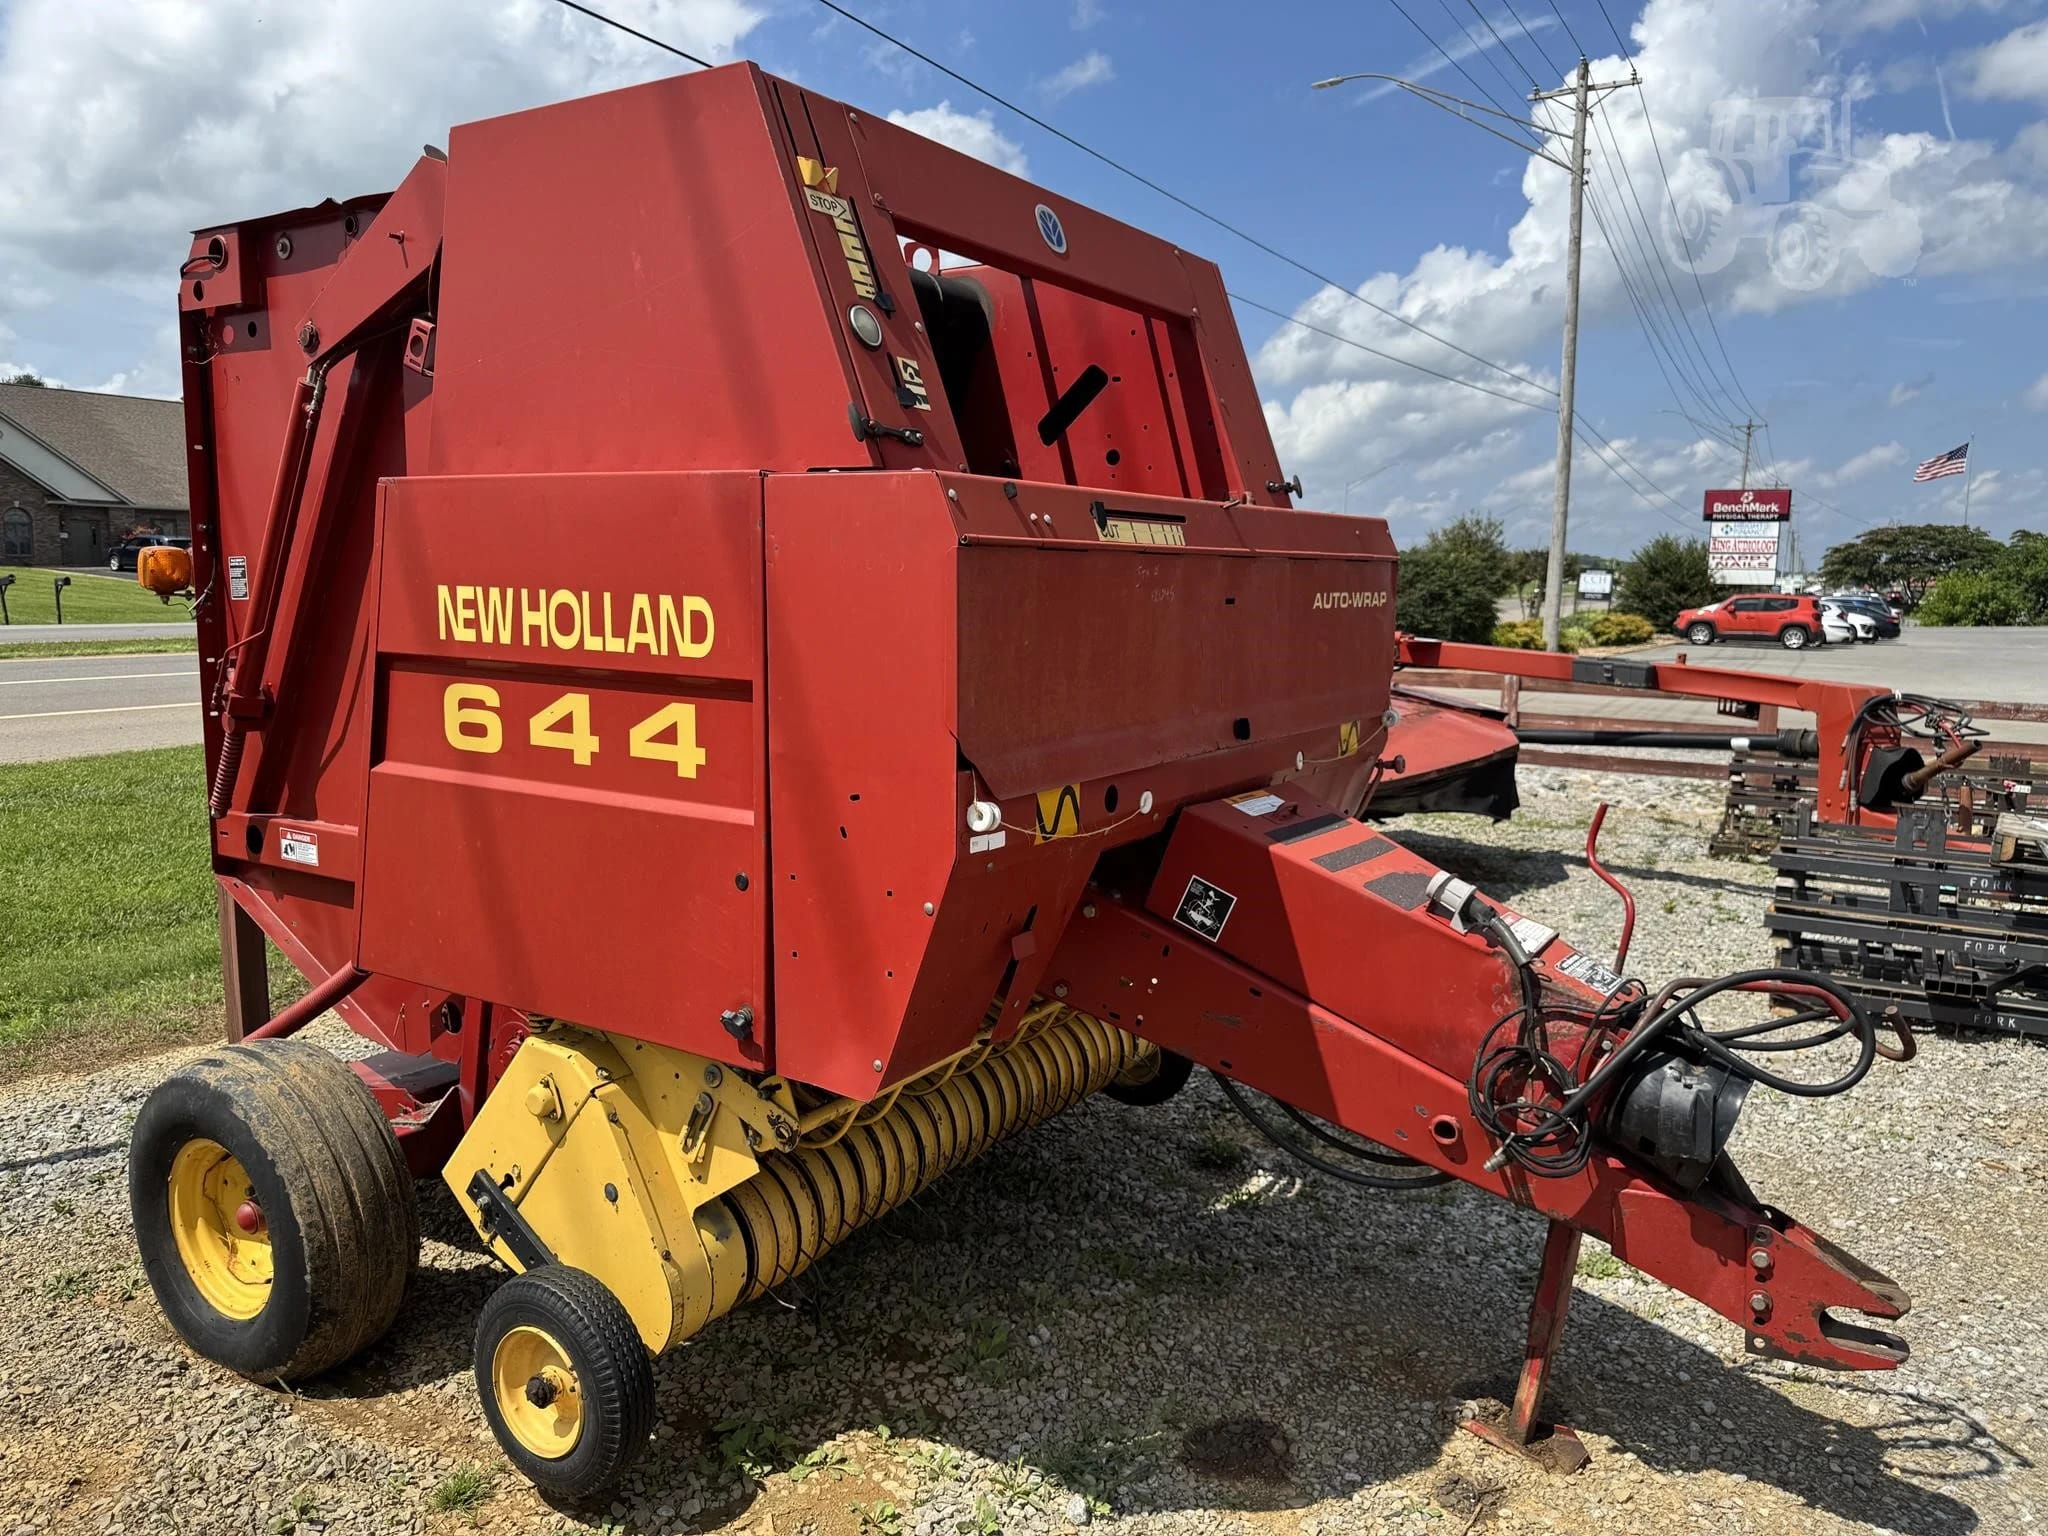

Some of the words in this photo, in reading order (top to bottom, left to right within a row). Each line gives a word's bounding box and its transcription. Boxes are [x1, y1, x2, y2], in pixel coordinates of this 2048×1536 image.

[809, 194, 838, 211] STOP
[1713, 502, 1779, 512] BenchMark
[437, 584, 514, 645] NEW
[520, 588, 715, 658] HOLLAND
[1969, 876, 2013, 891] FORK
[1963, 940, 2007, 955] FORK
[1973, 1013, 2017, 1028] FORK
